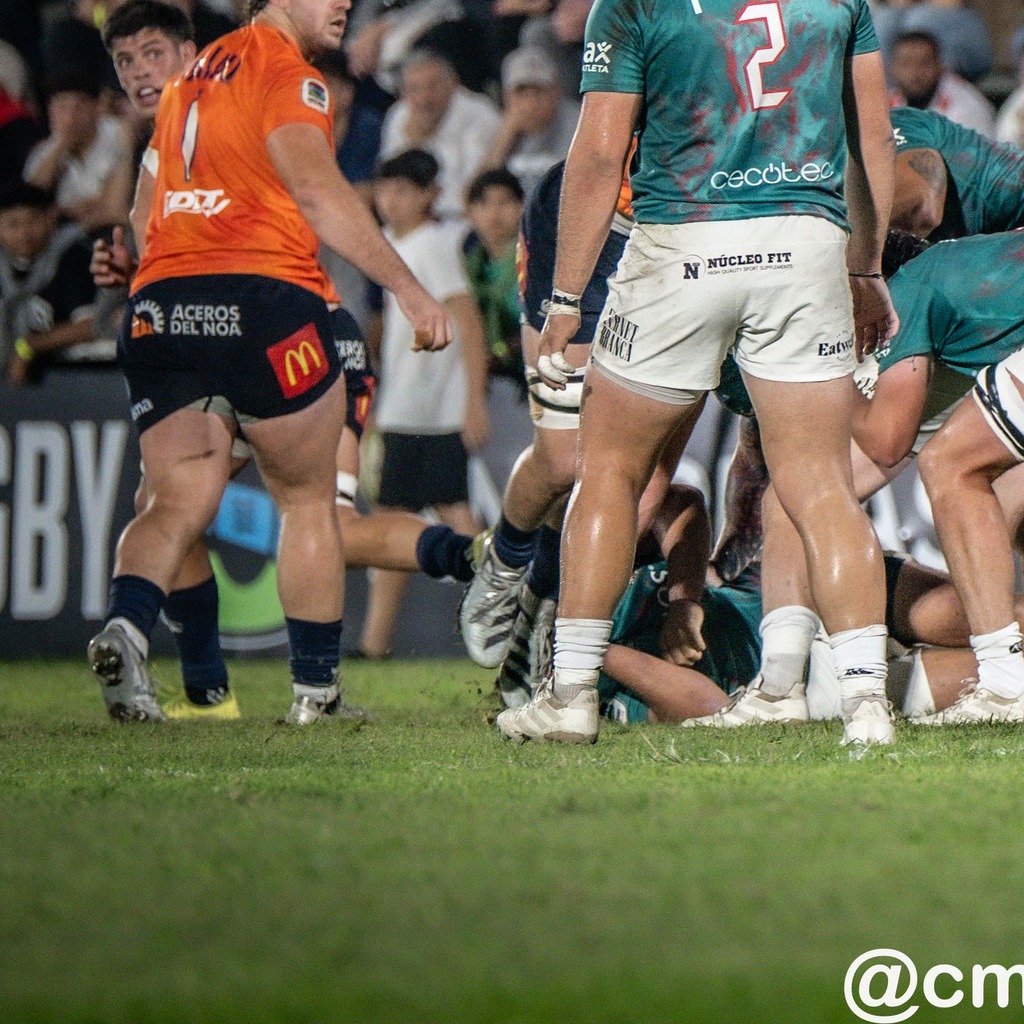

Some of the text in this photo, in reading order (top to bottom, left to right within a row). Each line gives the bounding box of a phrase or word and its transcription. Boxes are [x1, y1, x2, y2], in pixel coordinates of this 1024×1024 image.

[733, 0, 795, 111] 2
[710, 162, 834, 189] cecotec
[707, 252, 792, 269] NÚCLEO FIT
[170, 303, 241, 322] ACEROS
[169, 320, 243, 337] DEL NOA
[0, 420, 129, 621] BY
